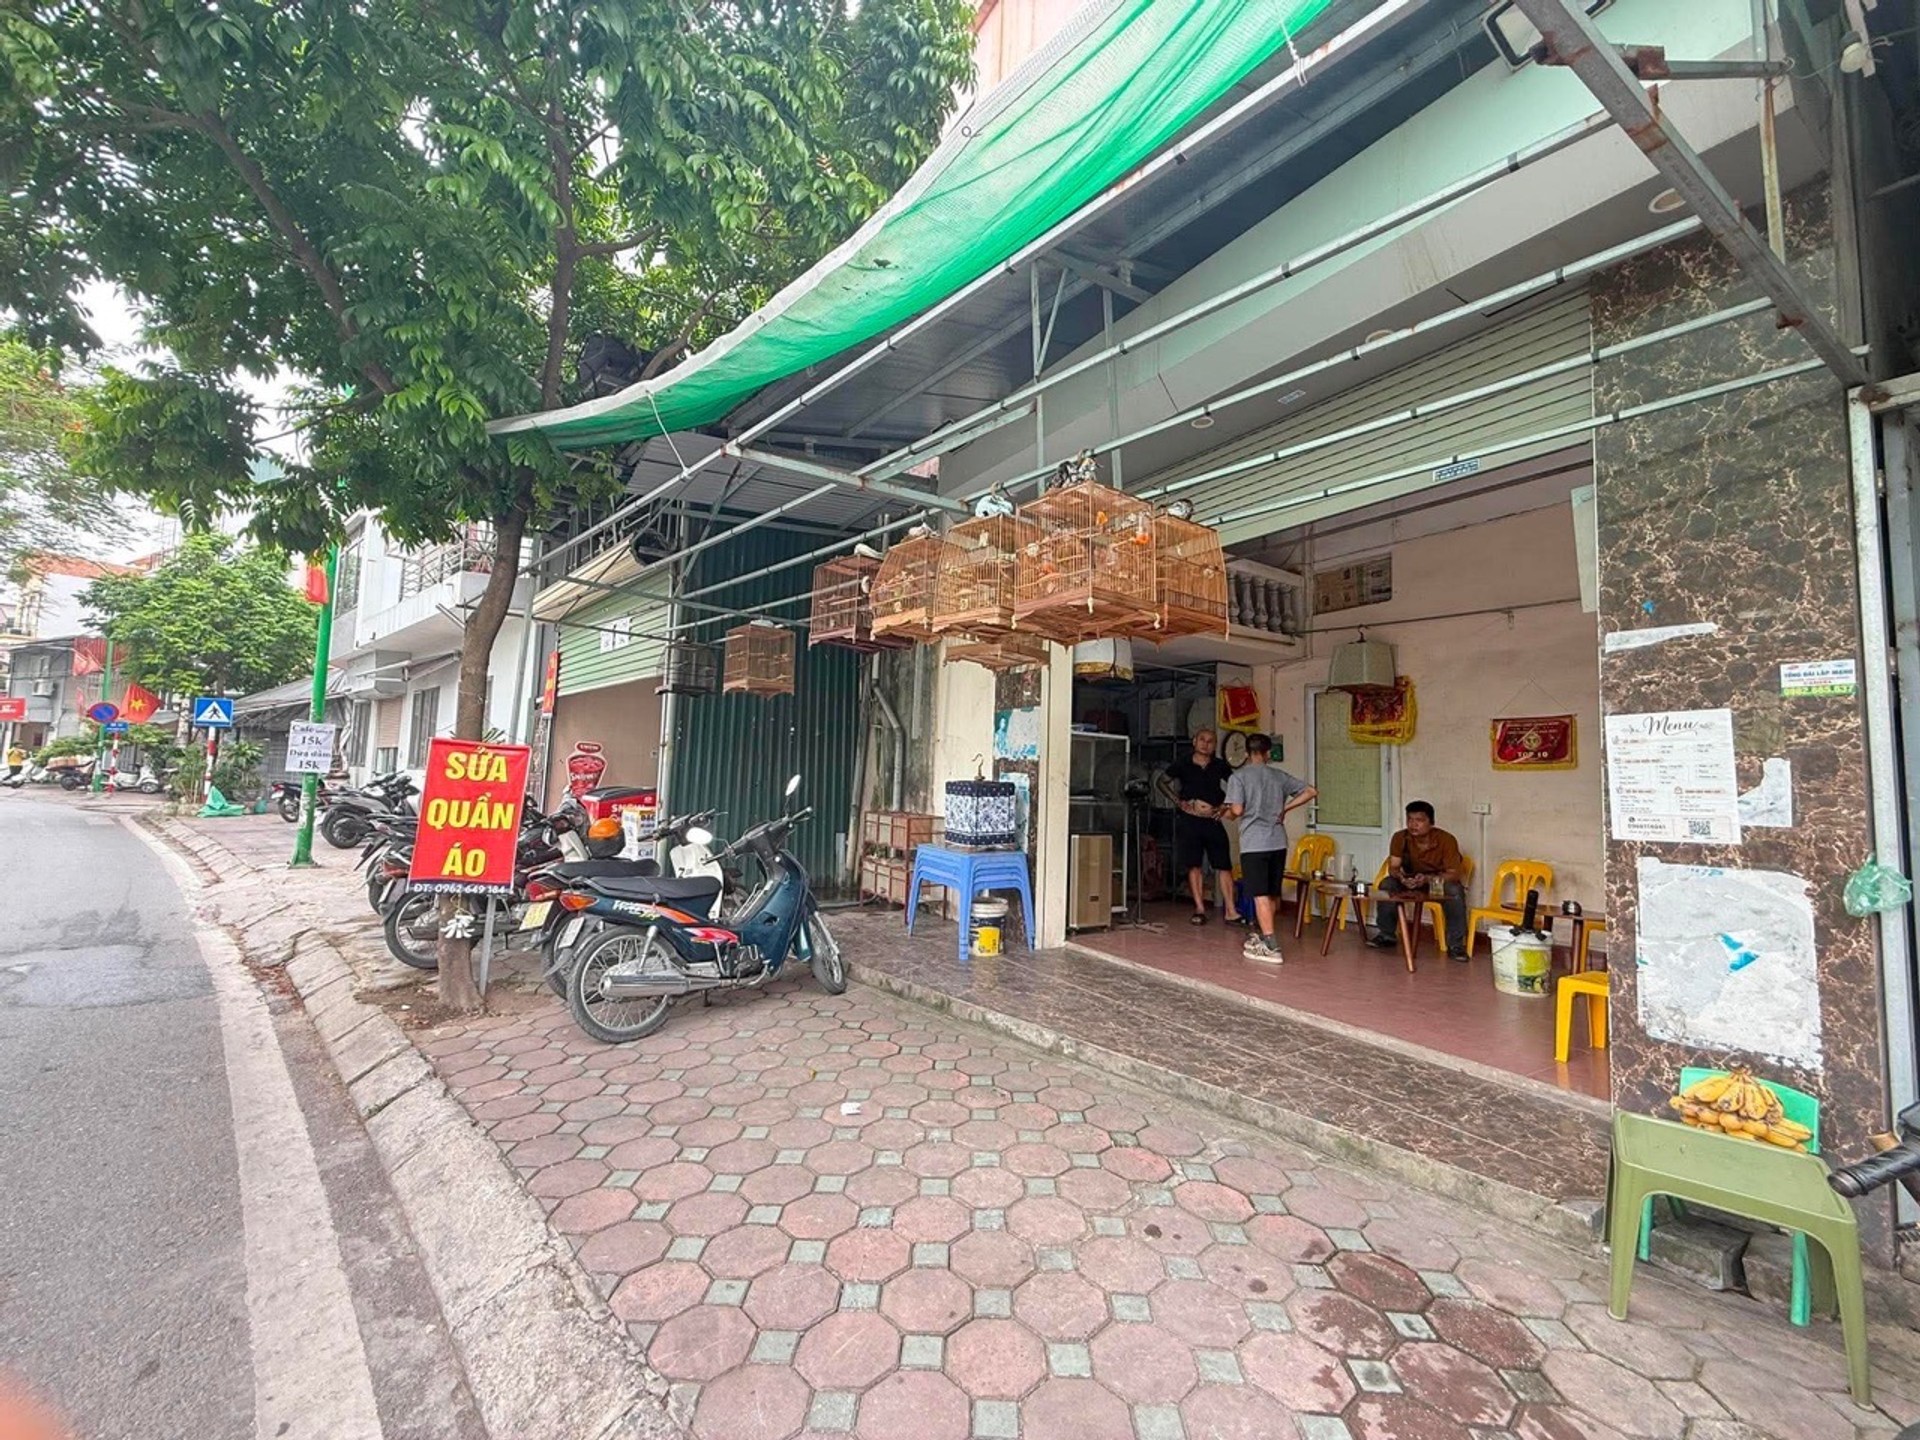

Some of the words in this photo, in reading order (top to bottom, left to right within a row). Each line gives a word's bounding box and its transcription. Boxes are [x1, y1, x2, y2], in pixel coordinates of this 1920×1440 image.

[1643, 715, 1698, 736] Menu
[302, 736, 322, 745] 15k
[300, 760, 320, 769] 15k
[445, 746, 508, 782] SỬA
[426, 792, 515, 830] QUẦN
[440, 842, 486, 877] ÁO
[434, 883, 462, 893] 0962
[464, 884, 485, 894] 649
[487, 885, 506, 894] 184
